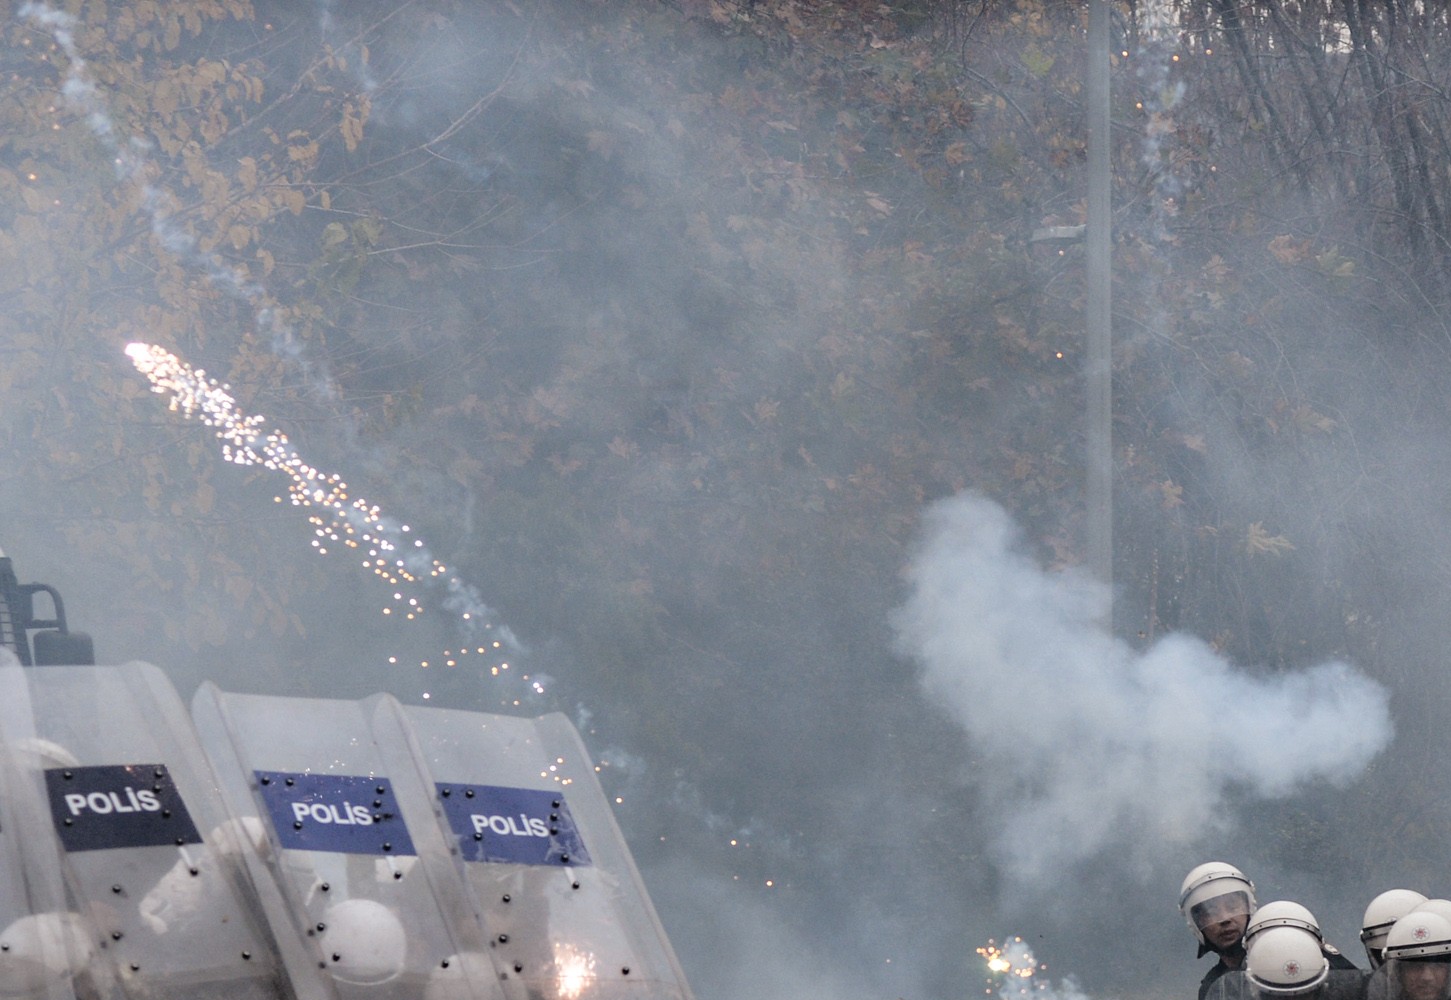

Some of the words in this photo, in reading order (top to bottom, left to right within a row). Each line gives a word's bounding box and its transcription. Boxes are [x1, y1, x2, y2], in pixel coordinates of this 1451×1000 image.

[64, 786, 162, 816] POLİS
[291, 801, 374, 826] POLİS
[470, 813, 549, 838] POLİS
